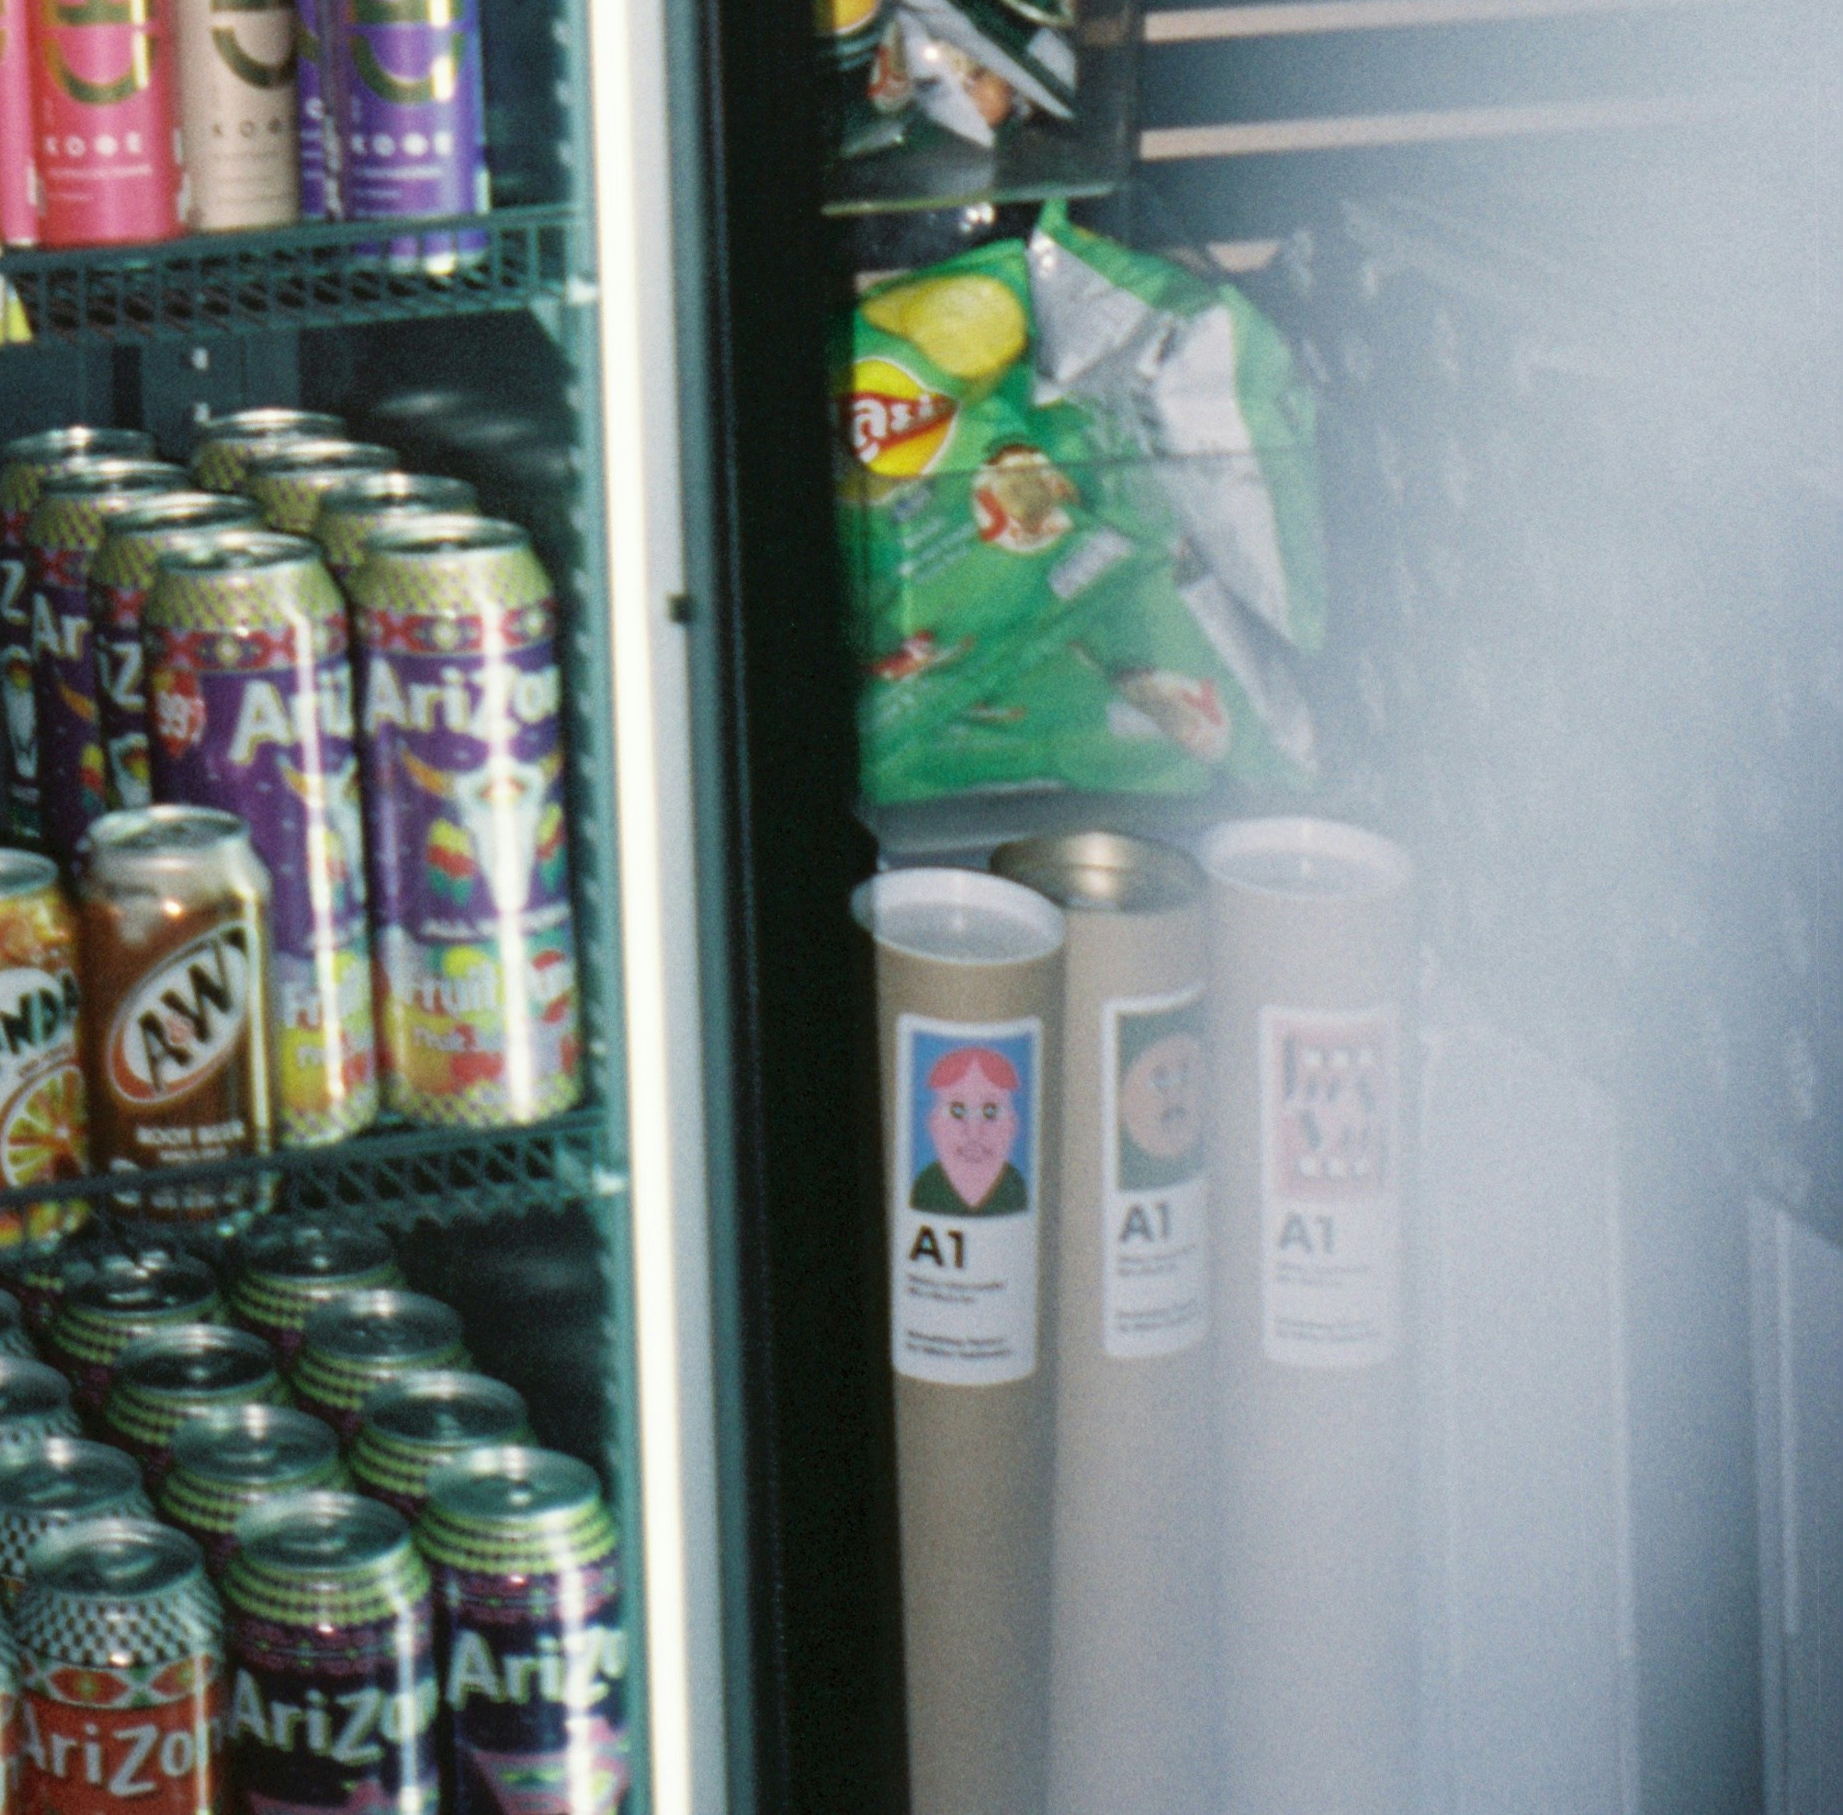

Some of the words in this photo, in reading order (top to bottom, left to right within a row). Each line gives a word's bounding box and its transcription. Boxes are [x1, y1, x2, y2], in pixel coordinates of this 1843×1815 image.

[1117, 1200, 1173, 1246] A1
[1277, 1211, 1340, 1257] A1
[908, 1226, 968, 1270] A1
